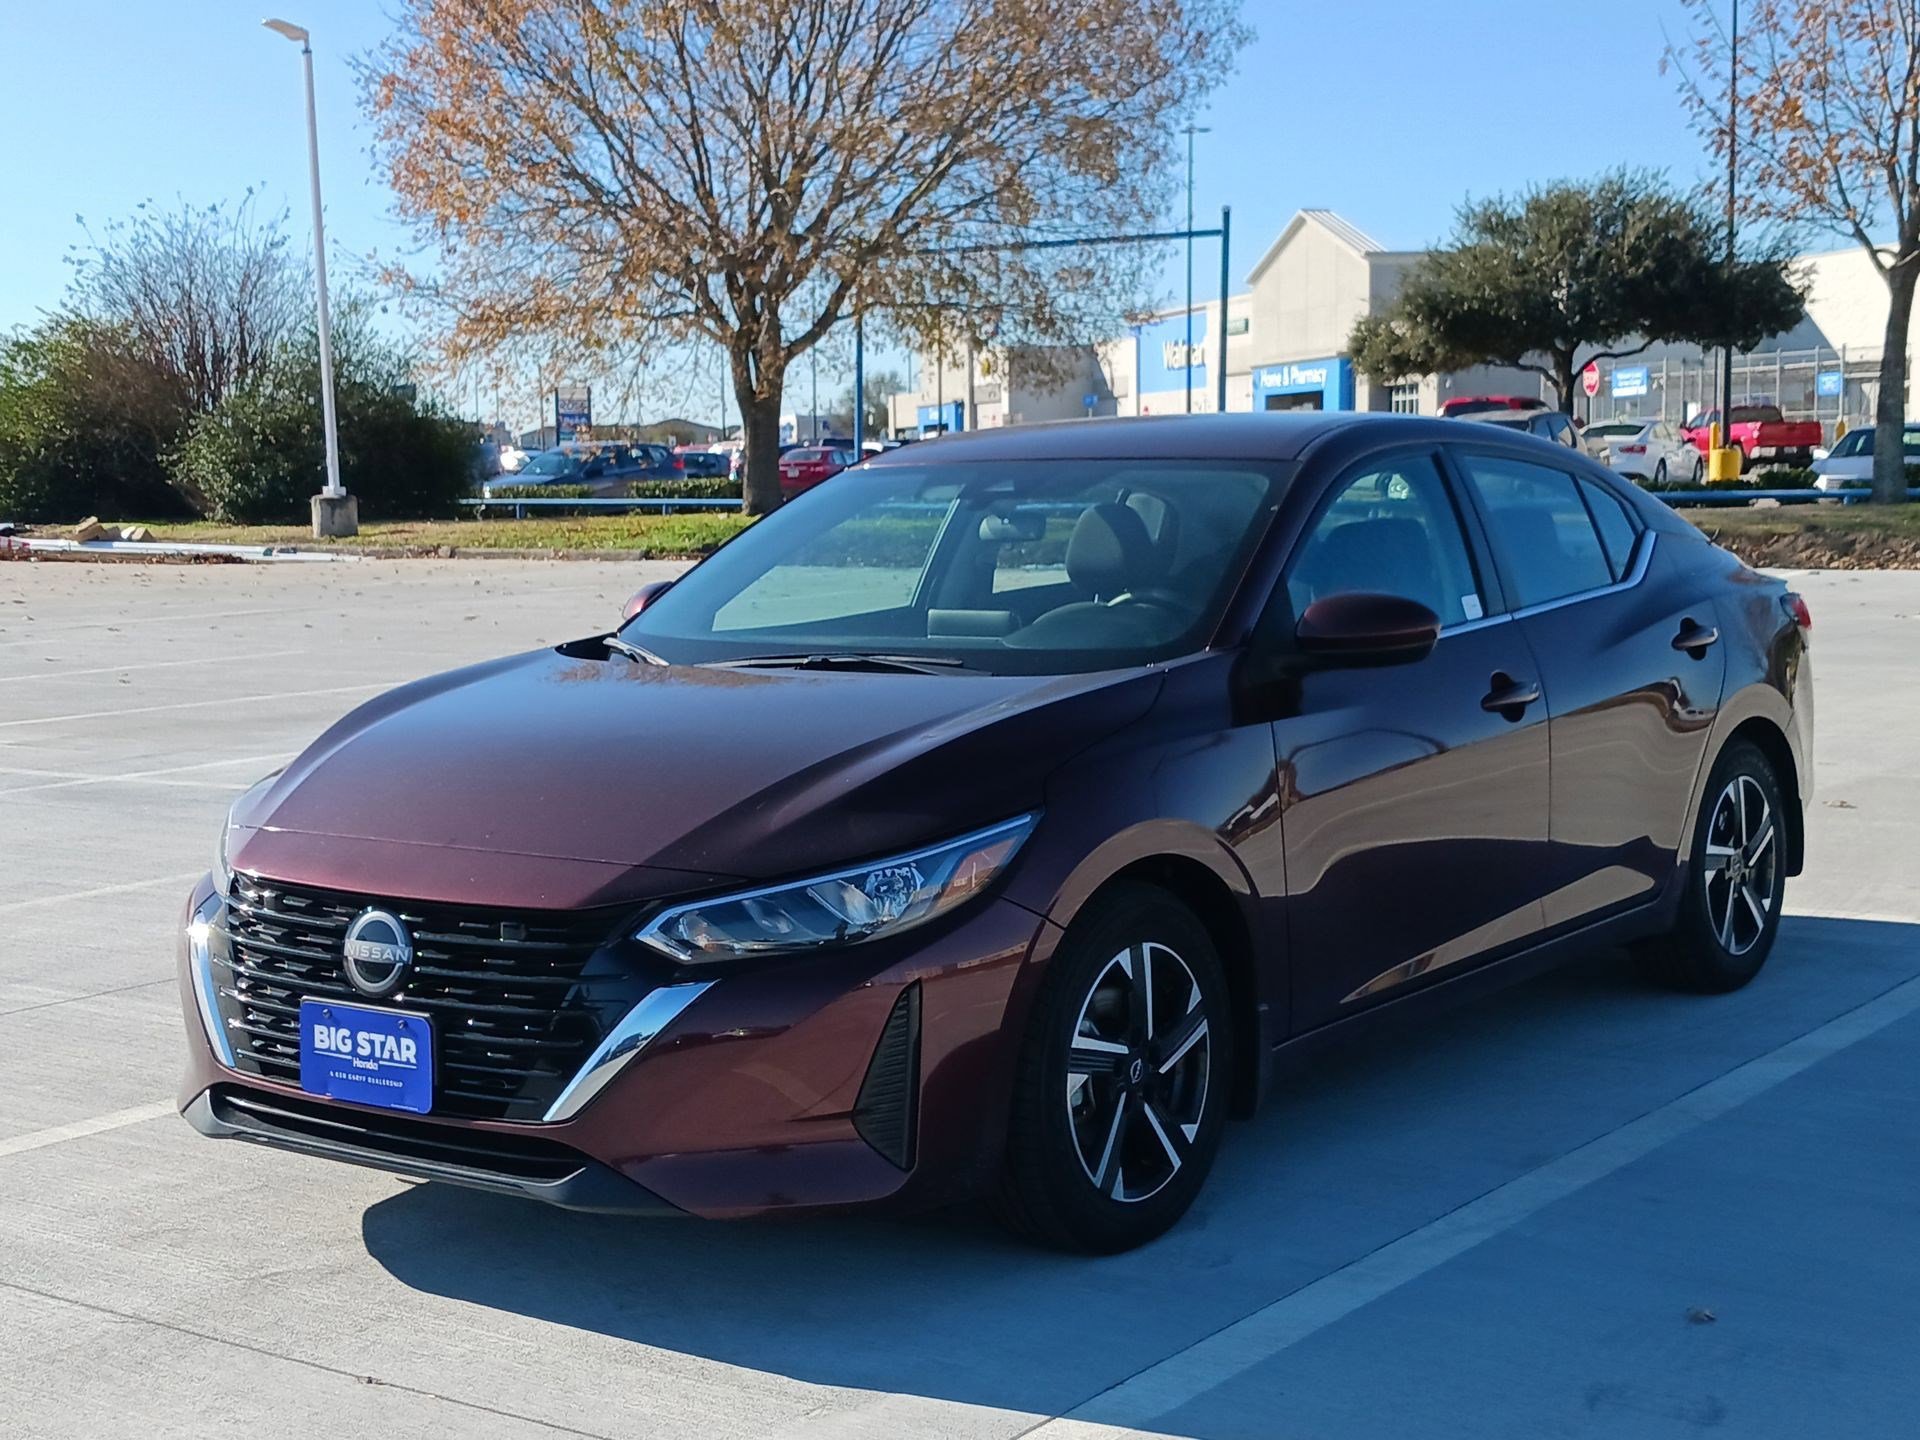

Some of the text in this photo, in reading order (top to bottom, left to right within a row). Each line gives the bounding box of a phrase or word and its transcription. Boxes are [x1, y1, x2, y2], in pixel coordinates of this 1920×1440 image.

[1260, 368, 1281, 387] Home
[1290, 365, 1327, 389] Pharmacy
[346, 942, 409, 961] NISSAN
[314, 1024, 417, 1064] BIG STAR
[353, 1057, 379, 1071] Honda
[367, 1076, 403, 1088] DEALERSHIP
